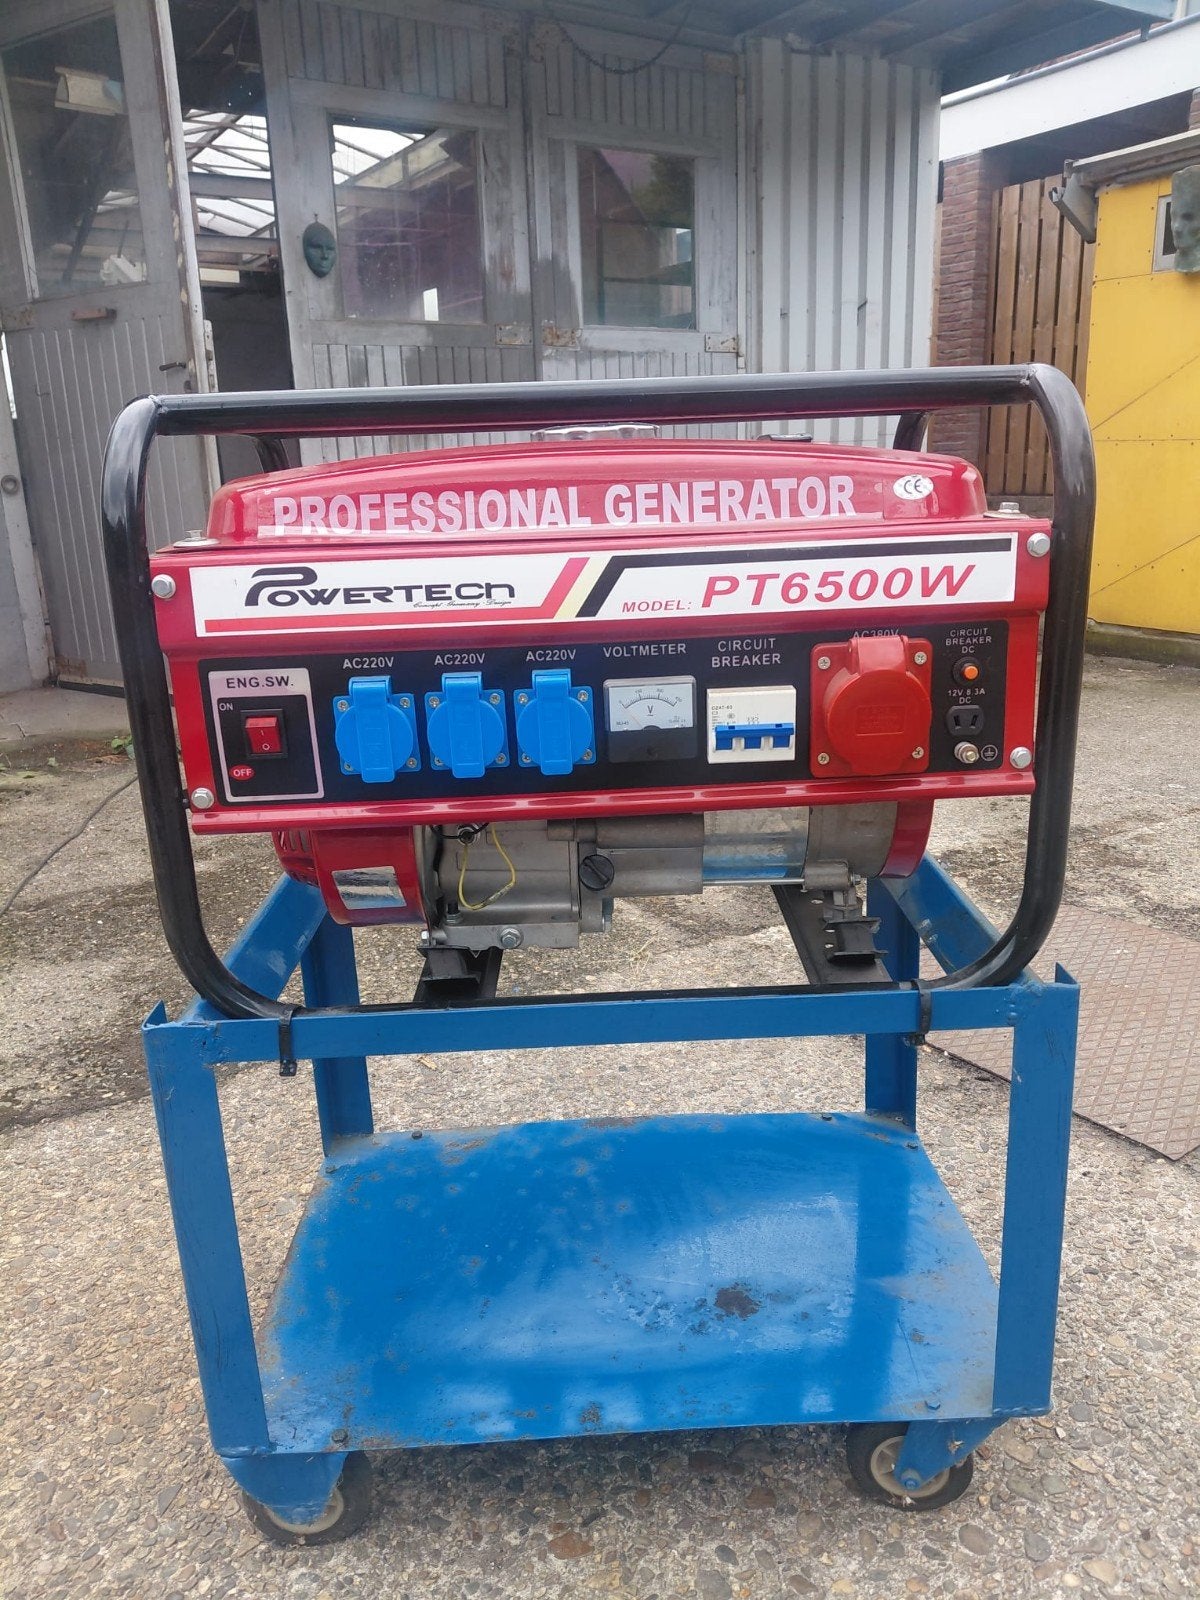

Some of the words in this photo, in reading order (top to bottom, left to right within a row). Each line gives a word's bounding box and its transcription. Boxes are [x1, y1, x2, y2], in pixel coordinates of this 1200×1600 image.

[273, 486, 592, 536] PROFESSIONAL
[604, 475, 857, 526] GENERATOR
[621, 600, 692, 613] MODEL:
[701, 564, 976, 608] PT6500W
[950, 628, 989, 637] CIRCUIT
[718, 638, 776, 652] CIRCUIT
[945, 636, 992, 646] BREAKER
[526, 649, 576, 662] AC220V
[603, 643, 687, 658] VOLTMETER
[342, 656, 394, 669] AC220V
[434, 653, 485, 666] AC220V
[711, 653, 781, 668] BREAKER
[226, 676, 294, 689] ENG.SW.
[948, 688, 963, 697] 12V
[219, 702, 234, 711] ON
[959, 696, 972, 704] DC
[233, 768, 253, 777] OFF
